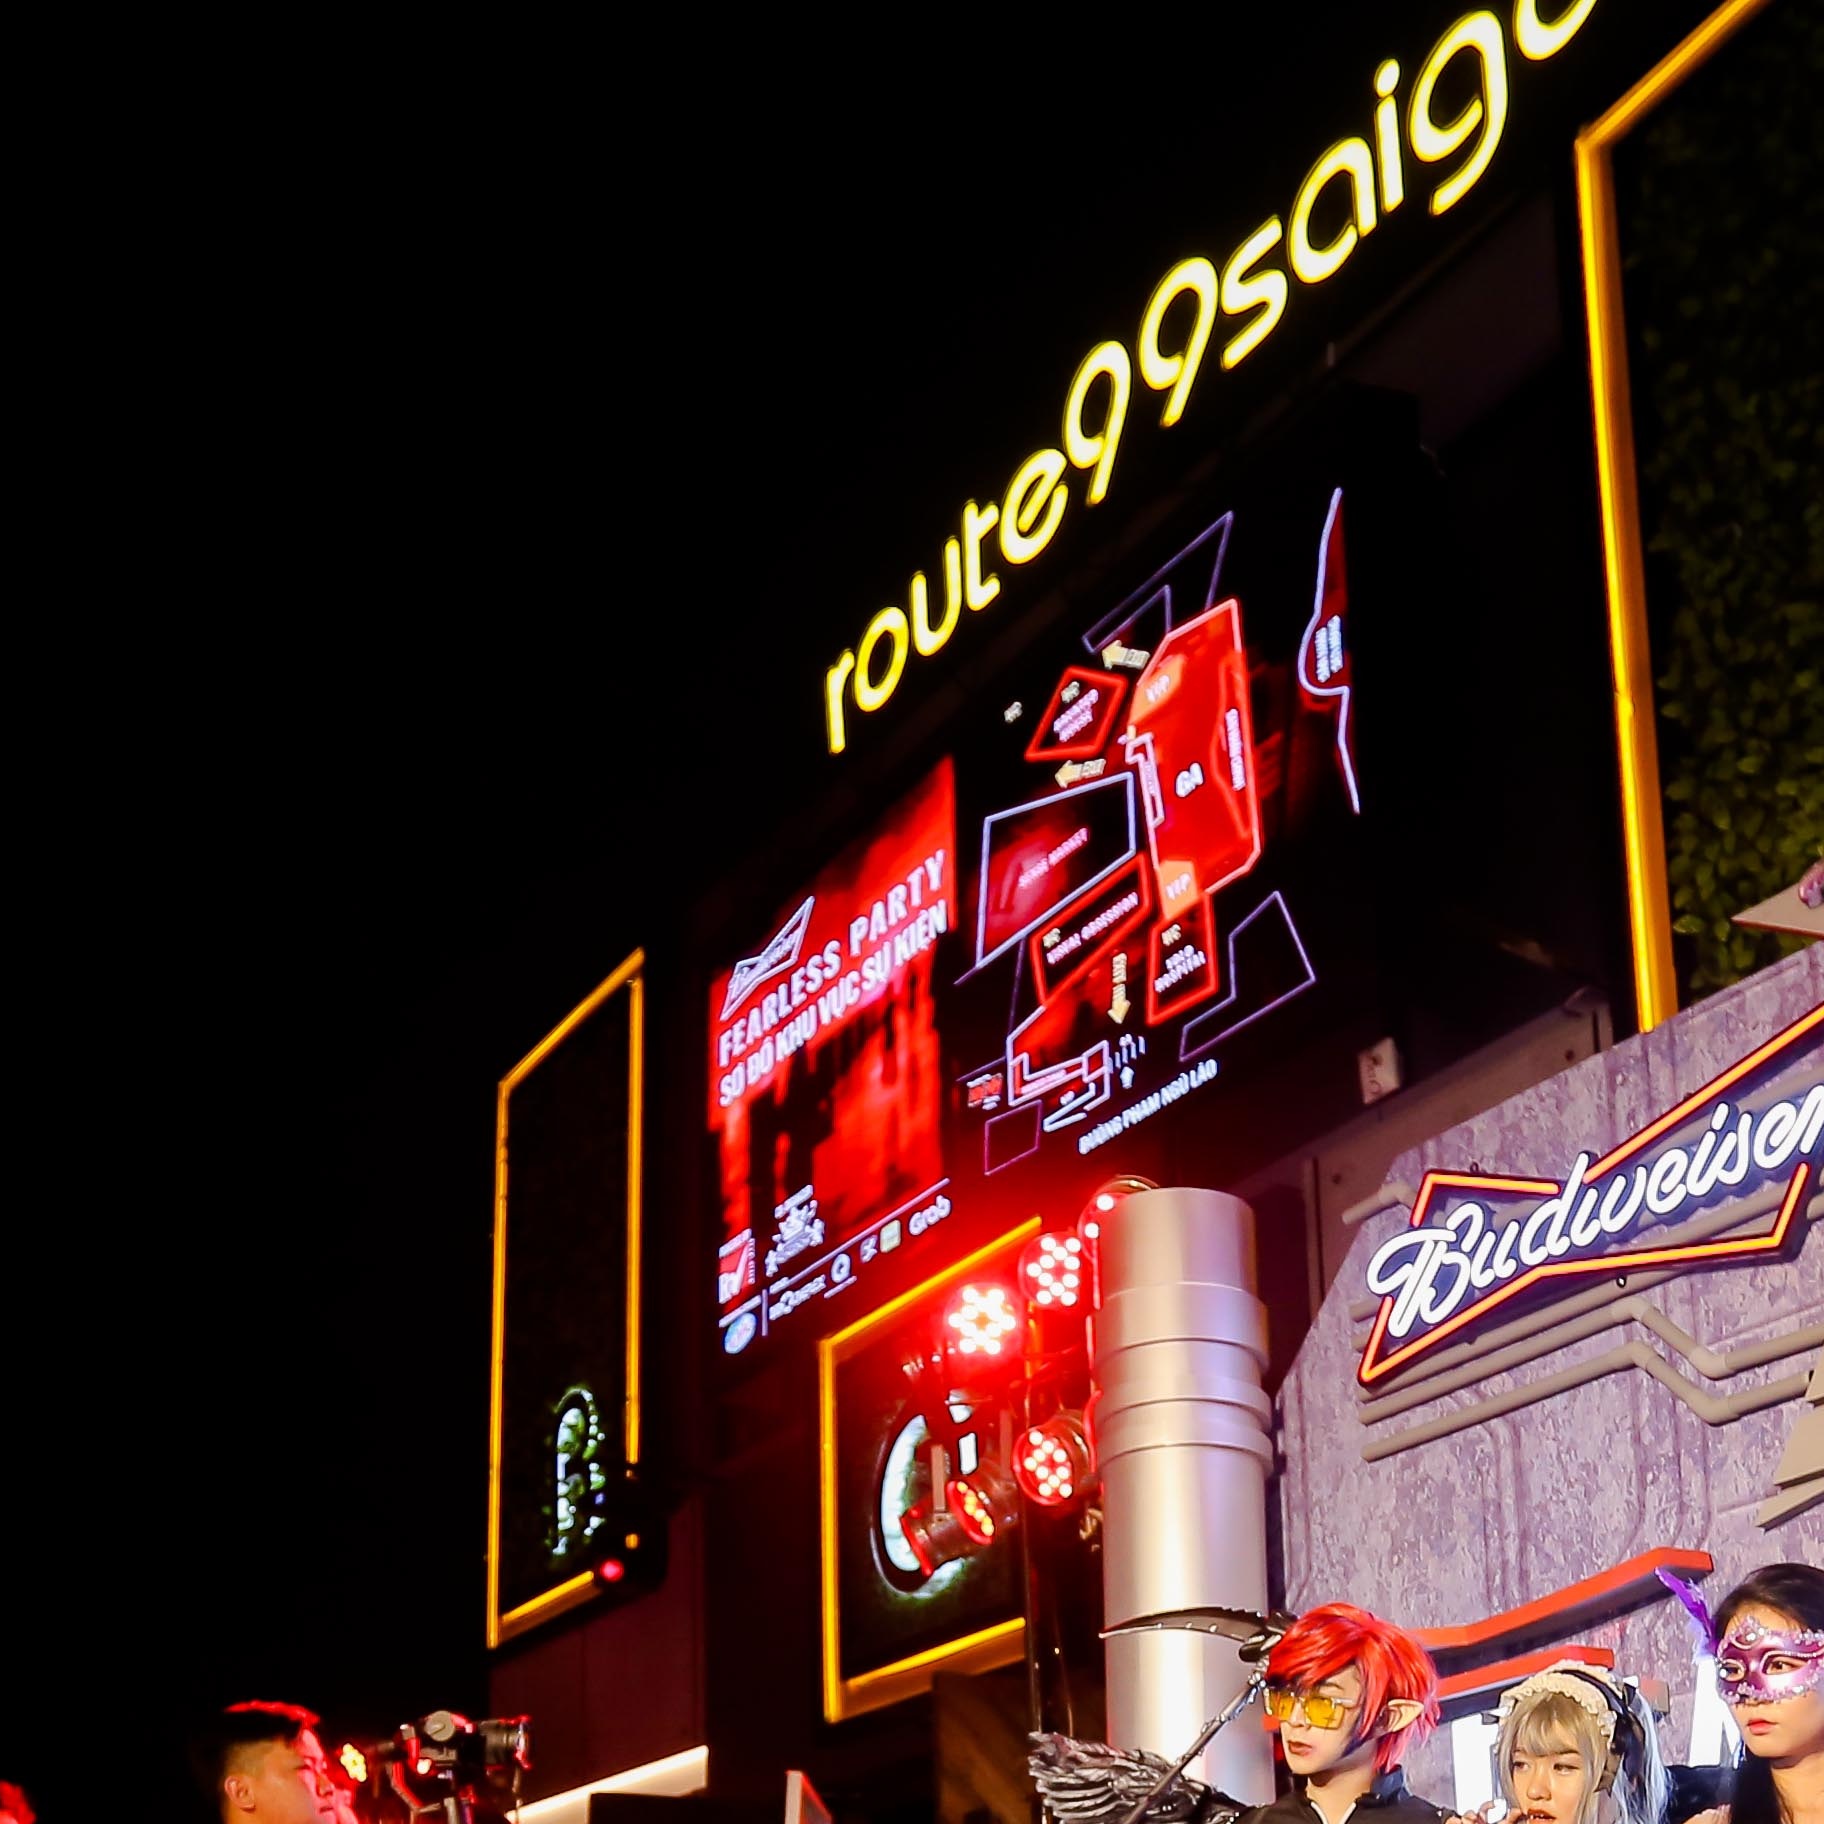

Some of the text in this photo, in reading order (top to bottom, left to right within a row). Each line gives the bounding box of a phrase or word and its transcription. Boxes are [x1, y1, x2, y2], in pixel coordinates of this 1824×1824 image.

[718, 939, 841, 1068] FEARLESS
[848, 848, 945, 957] PARTY
[775, 1003, 818, 1062] KHU
